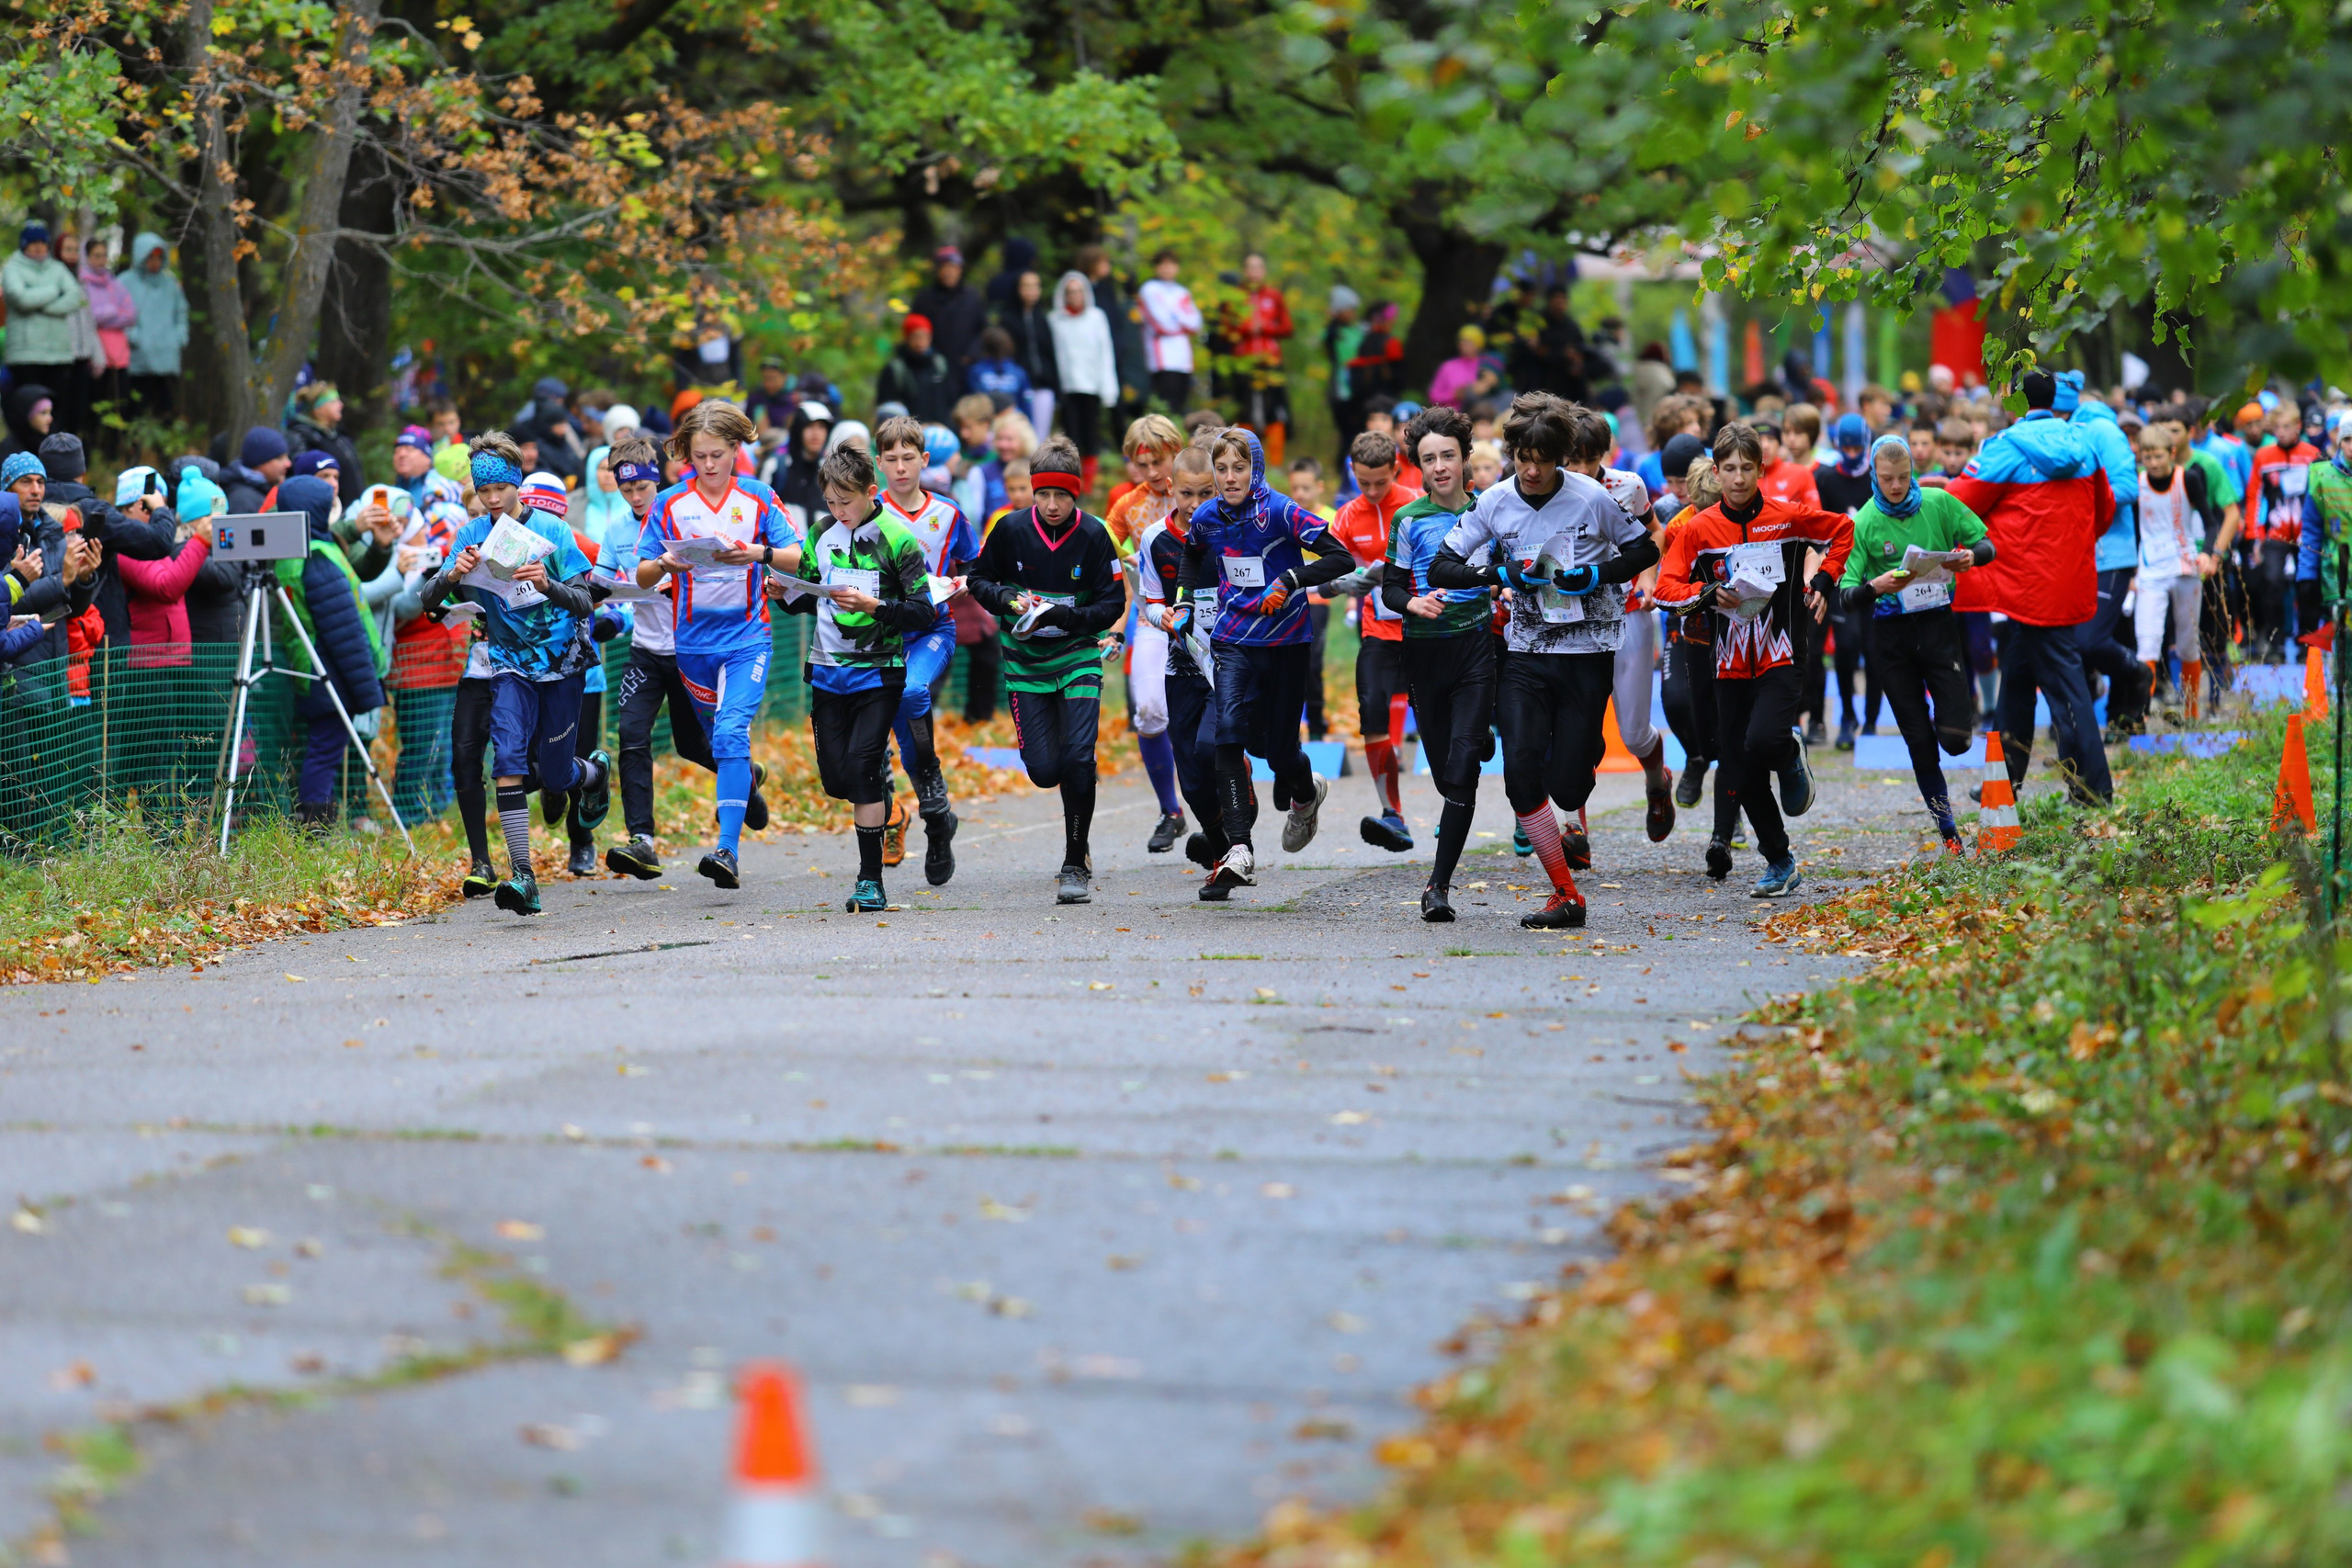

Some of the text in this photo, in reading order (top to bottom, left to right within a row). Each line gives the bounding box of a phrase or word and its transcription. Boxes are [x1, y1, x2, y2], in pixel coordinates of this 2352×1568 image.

[1752, 522, 1792, 534] МОСКВА
[1233, 567, 1251, 578] 267
[1755, 564, 1772, 576] 49
[515, 581, 532, 596] 261
[1914, 584, 1932, 597] 264
[1199, 606, 1218, 618] 255
[481, 658, 492, 668] 26
[750, 663, 764, 683] СШ
[548, 721, 575, 744] noname
[1229, 779, 1239, 809] ARSWEAR
